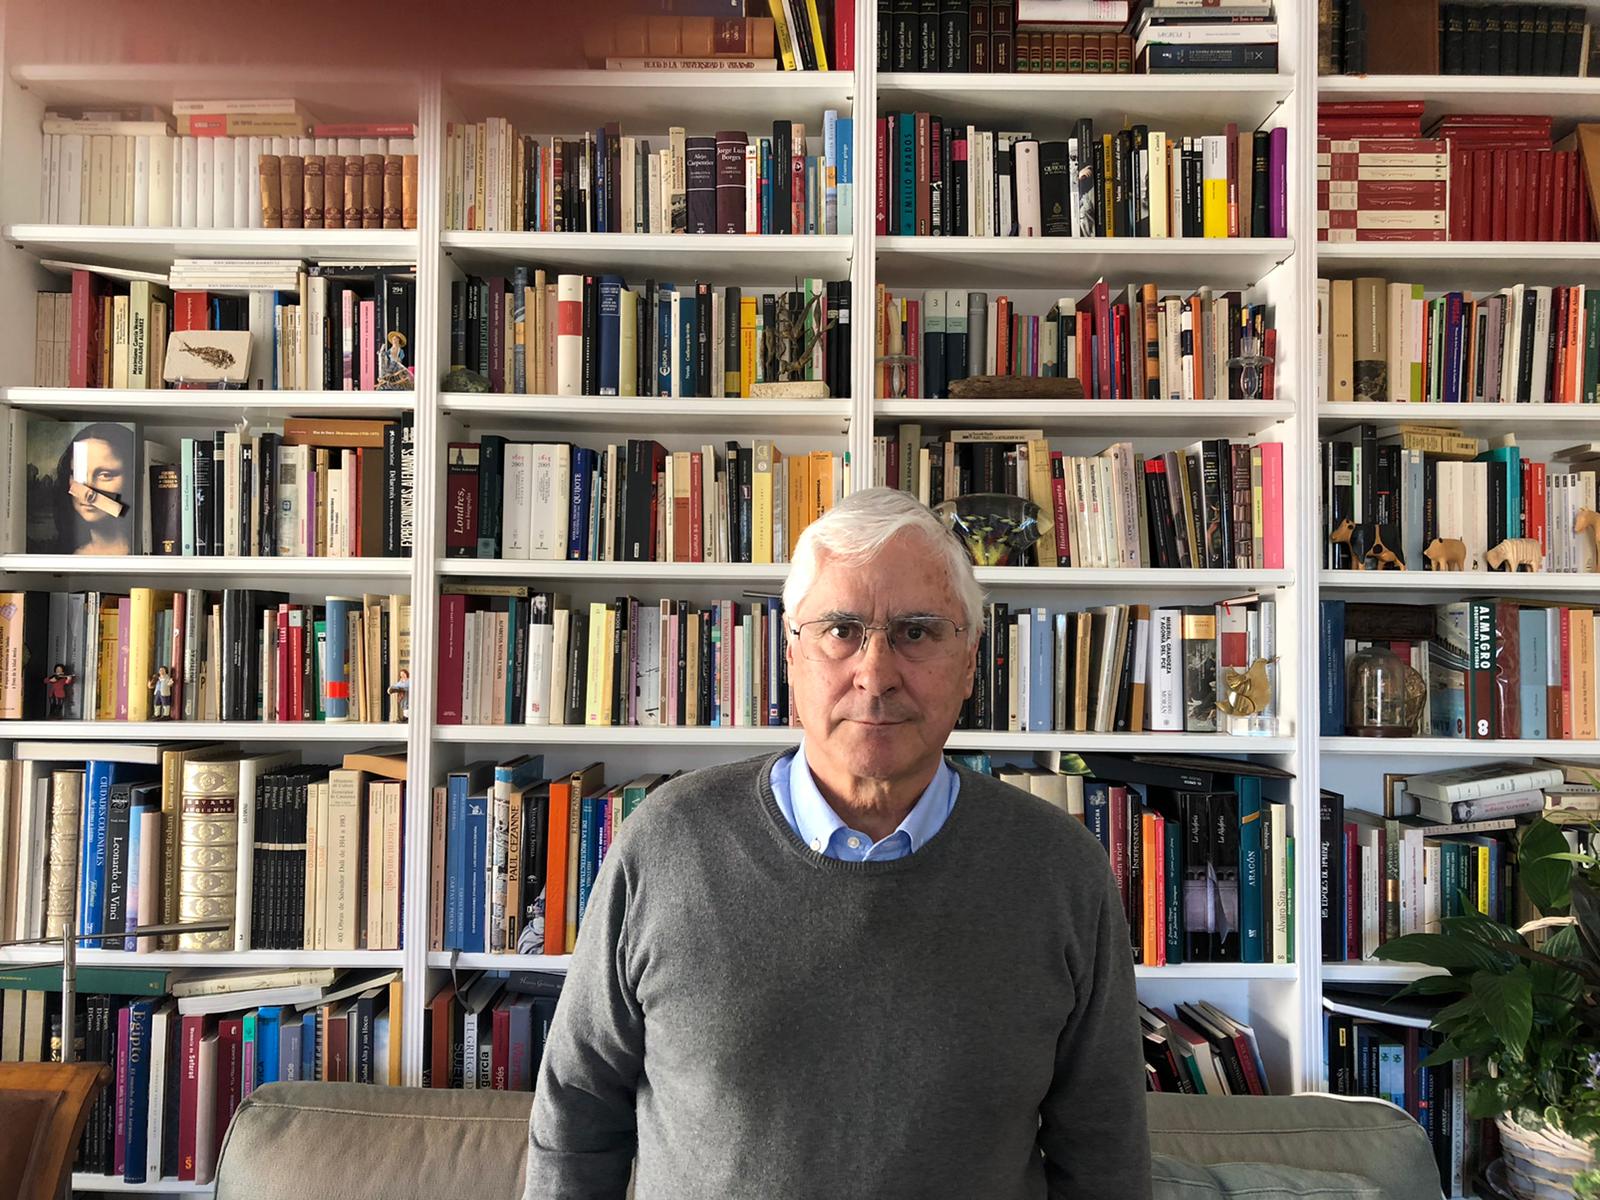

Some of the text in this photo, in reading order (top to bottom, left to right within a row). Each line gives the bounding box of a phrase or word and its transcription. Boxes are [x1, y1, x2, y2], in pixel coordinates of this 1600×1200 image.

[904, 134, 913, 213] EMILIO PRADOS
[388, 470, 397, 499] Delacroix
[401, 449, 414, 546] EXPRESIONISTAS ALEMANES
[574, 472, 582, 504] QUIJOTE
[454, 487, 466, 534] Londres,
[1059, 523, 1067, 550] Historia
[1479, 606, 1491, 669] ALMAGRO
[96, 776, 108, 866] CIUDADES COLONIALES
[571, 786, 579, 834] REMBRANDT
[338, 835, 346, 848] 1914
[338, 850, 346, 858] de
[387, 822, 398, 851] Vincent
[509, 805, 520, 882] PAUL CEZANNE
[580, 820, 588, 887] DE LA ARQUITECTURA
[109, 837, 123, 920] Leonardo da Vinci
[163, 816, 174, 924] Grandes Horas de Rohan
[338, 859, 346, 873] Dalí
[384, 870, 396, 891] Gogh
[1246, 850, 1256, 887] ARAGÓN
[338, 874, 346, 900] Salvador
[338, 902, 346, 911] de
[338, 912, 346, 931] Obras
[1277, 890, 1287, 933] Álvaro Siza
[128, 1011, 147, 1063] Egipto
[361, 1015, 369, 1033] Hoces
[465, 1021, 476, 1078] EL GRIEGO
[480, 1052, 490, 1088] garcía
